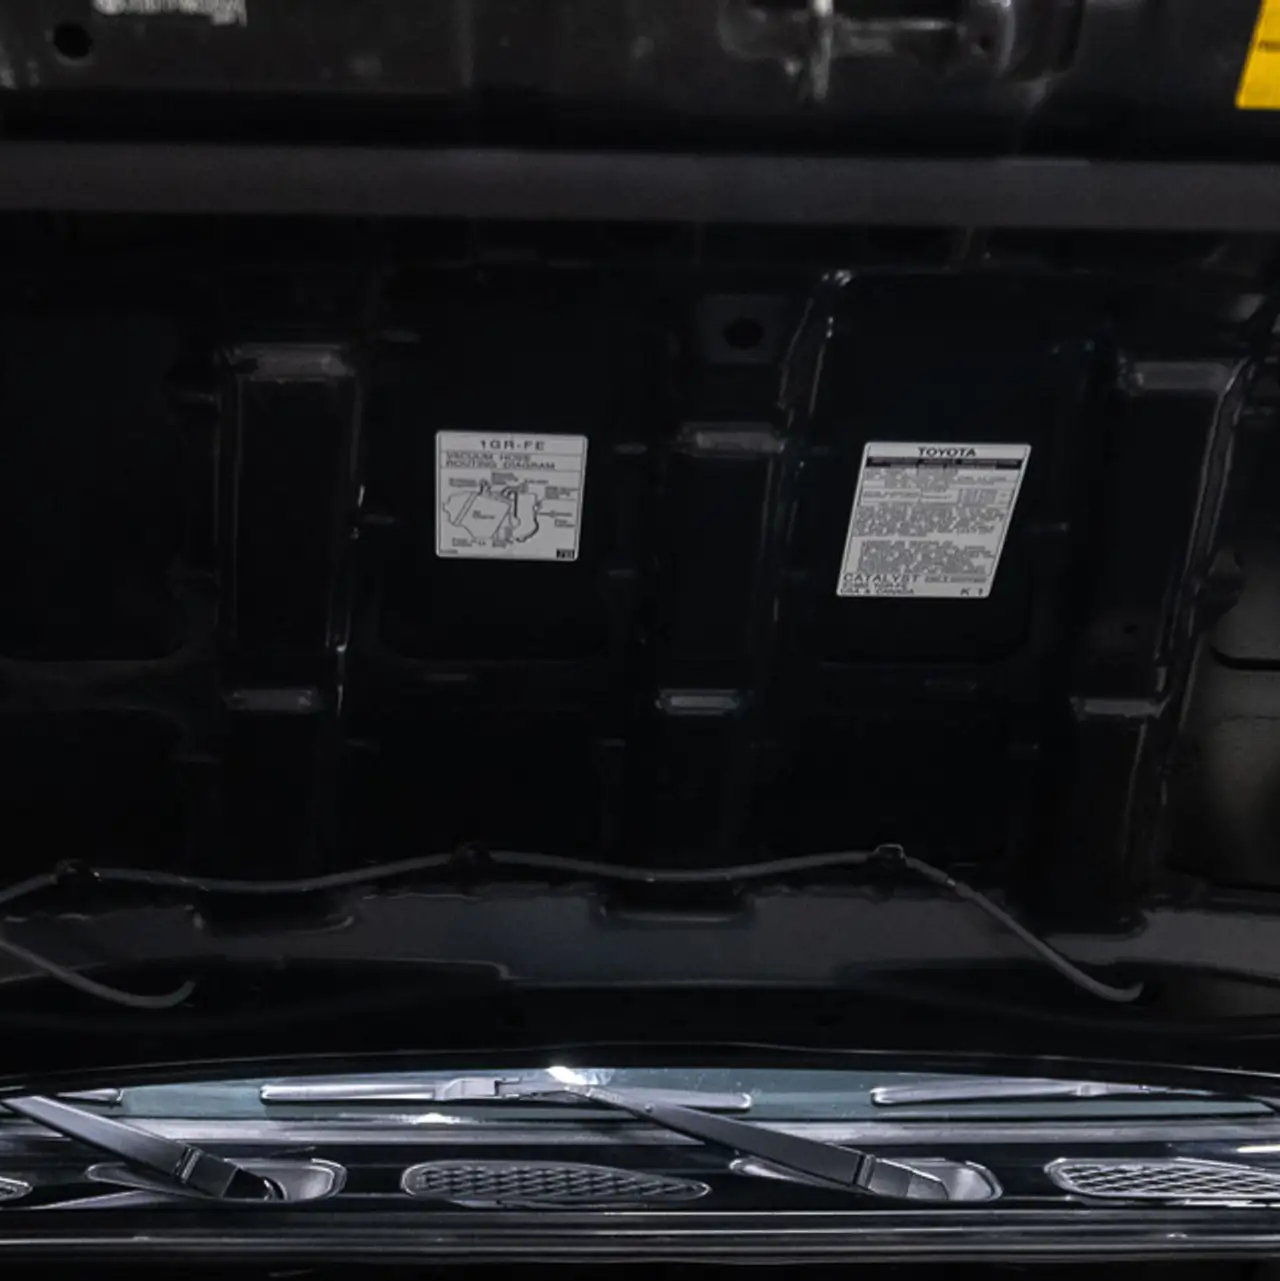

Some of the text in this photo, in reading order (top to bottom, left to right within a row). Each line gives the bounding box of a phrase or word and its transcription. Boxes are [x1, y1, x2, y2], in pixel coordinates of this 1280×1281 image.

[480, 440, 546, 451] 1GR-FE
[917, 447, 977, 457] TOYOTA
[843, 573, 918, 582] CATALYST
